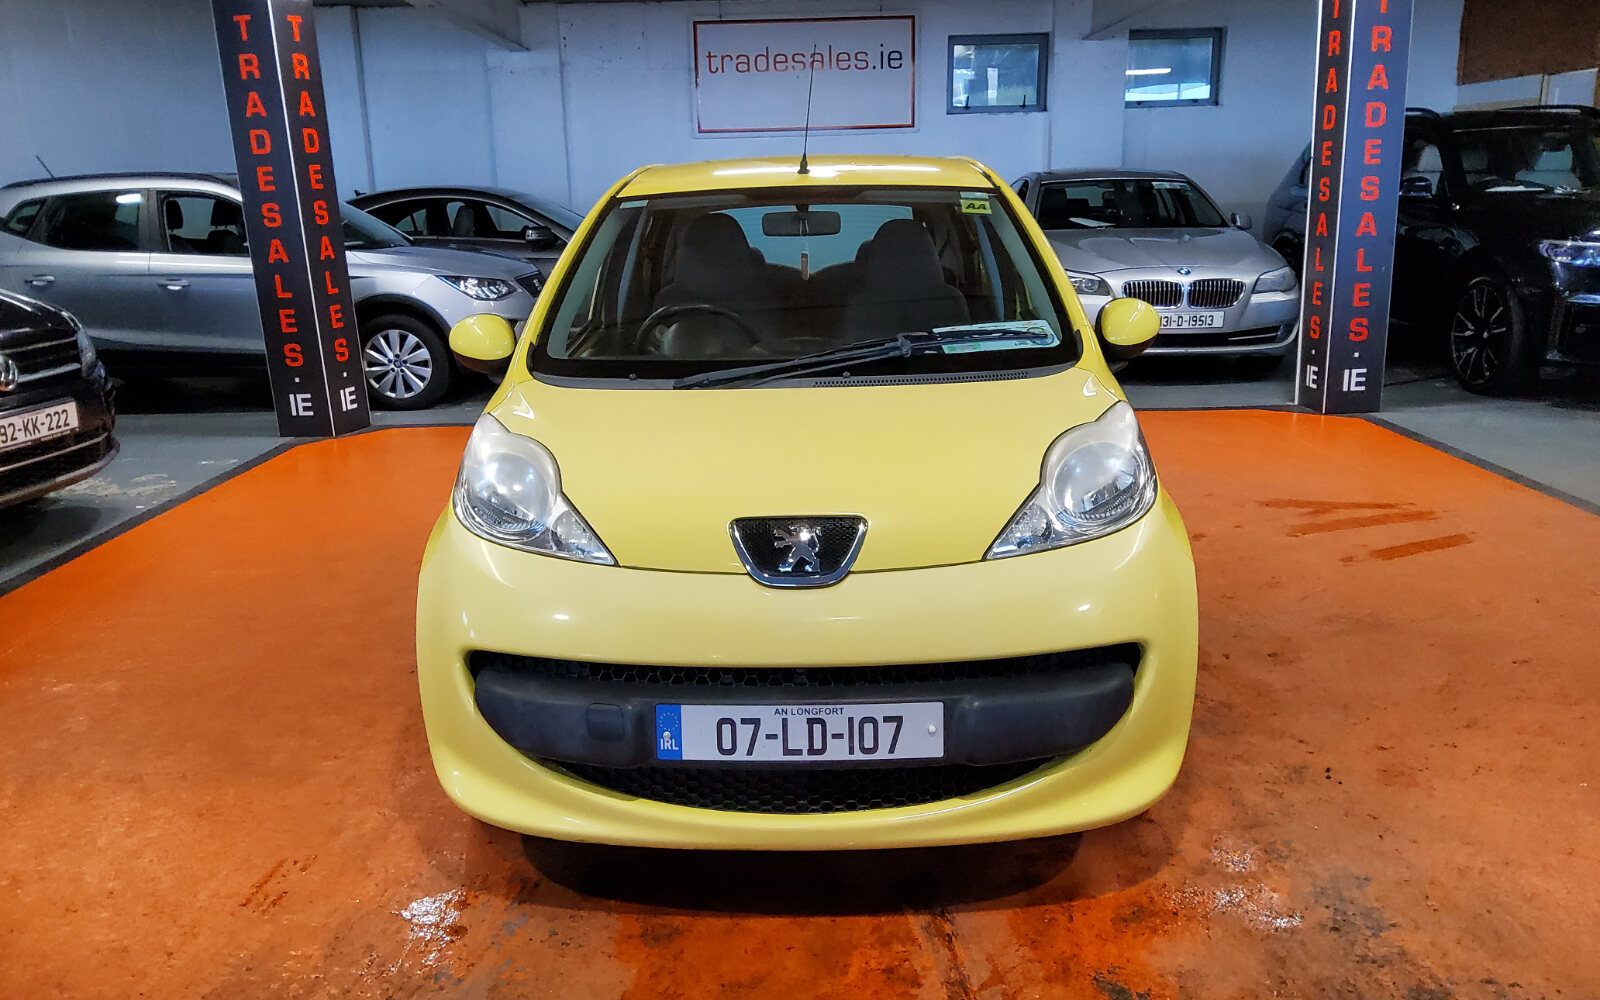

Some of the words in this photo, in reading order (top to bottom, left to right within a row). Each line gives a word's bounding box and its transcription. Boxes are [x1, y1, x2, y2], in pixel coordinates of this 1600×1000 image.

[706, 43, 903, 74] tradesales.ie
[966, 202, 987, 210] AA
[0, 409, 70, 443] 92-KK-222
[791, 707, 844, 716] LONGFORT
[660, 738, 679, 750] IRL
[716, 715, 904, 757] 07-LD-107
